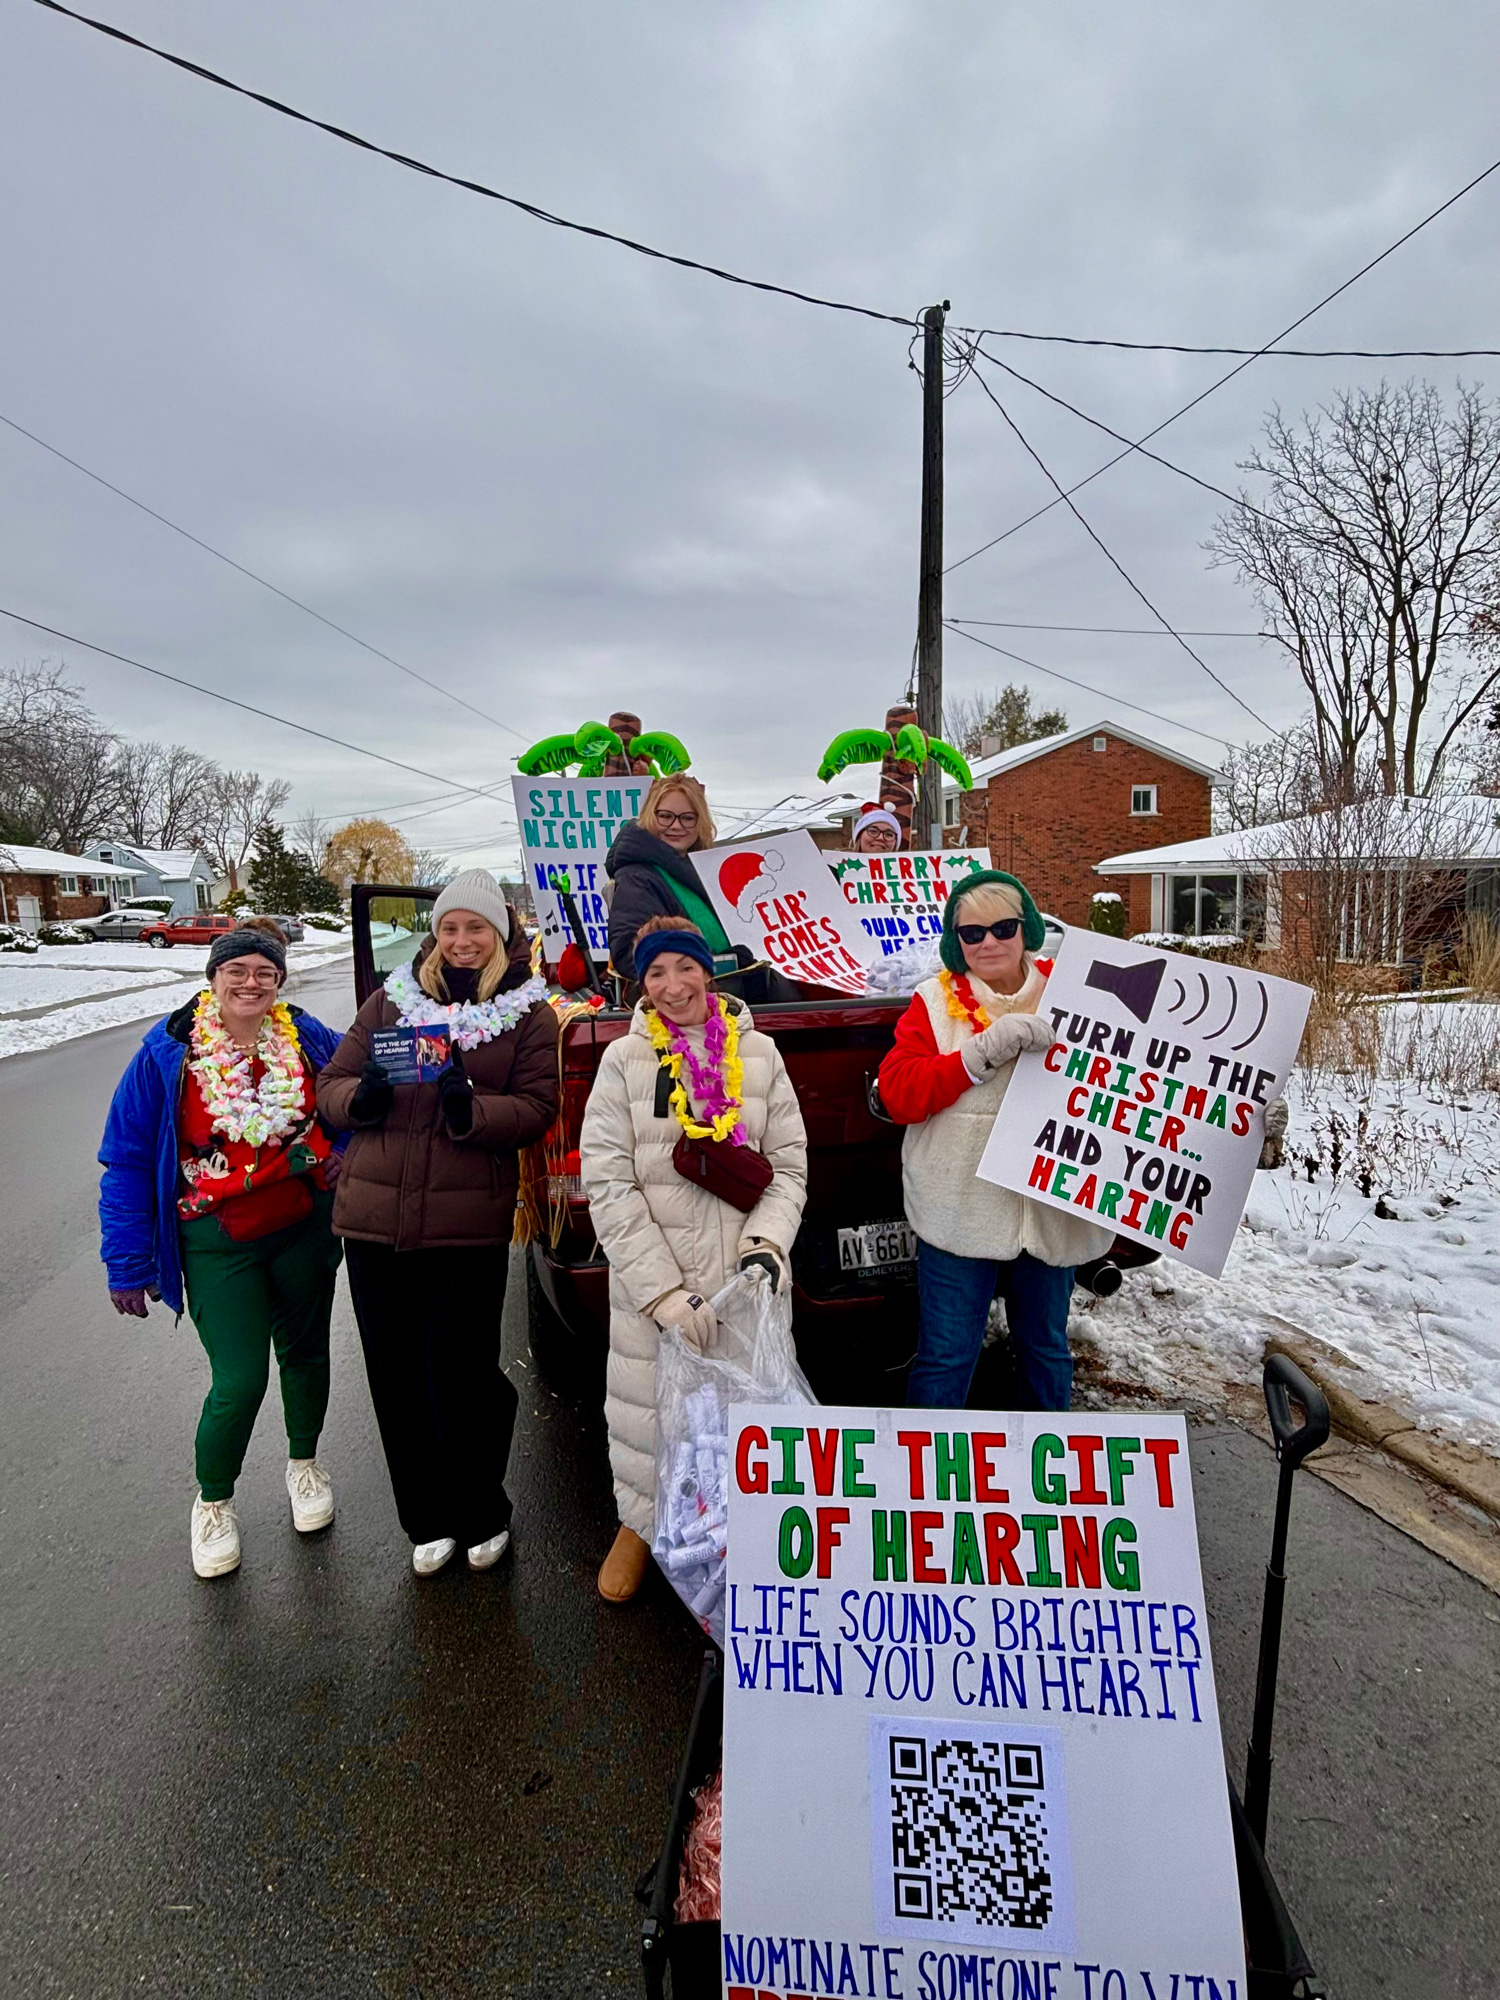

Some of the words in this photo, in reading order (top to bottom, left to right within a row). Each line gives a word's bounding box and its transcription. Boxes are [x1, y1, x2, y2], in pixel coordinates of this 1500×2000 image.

[529, 789, 641, 818] SILENT
[843, 880, 958, 904] CHRISTM
[868, 856, 941, 880] MERRY
[755, 890, 809, 932] EAR'
[763, 917, 841, 964] COMES
[890, 904, 940, 915] FROM
[782, 946, 862, 982] SANTA
[1043, 1043, 1254, 1137] CHRISTMAS
[1049, 1007, 1135, 1059] TURN
[1146, 1037, 1191, 1074] UP
[1207, 1054, 1276, 1106] THE
[1028, 1154, 1194, 1251] HEARING
[1033, 1119, 1102, 1166] AND
[1123, 1144, 1212, 1216] YOUR
[735, 1425, 877, 1498] GIVE
[897, 1431, 1010, 1504] THE
[1031, 1432, 1180, 1508] GIFT
[778, 1505, 850, 1580] OF
[872, 1509, 1142, 1592] HEARING
[730, 1583, 820, 1639] LIFE
[839, 1589, 977, 1648] SOUNDS
[992, 1597, 1202, 1660] BRIGHTER
[731, 1636, 843, 1696] WHEN
[854, 1643, 936, 1702] YOU
[952, 1651, 1028, 1710] CAN
[1037, 1655, 1149, 1718] HEAR
[1151, 1660, 1203, 1723] IT
[722, 1934, 904, 2000] NOMINATE
[917, 1950, 1061, 2000] SOMEONE
